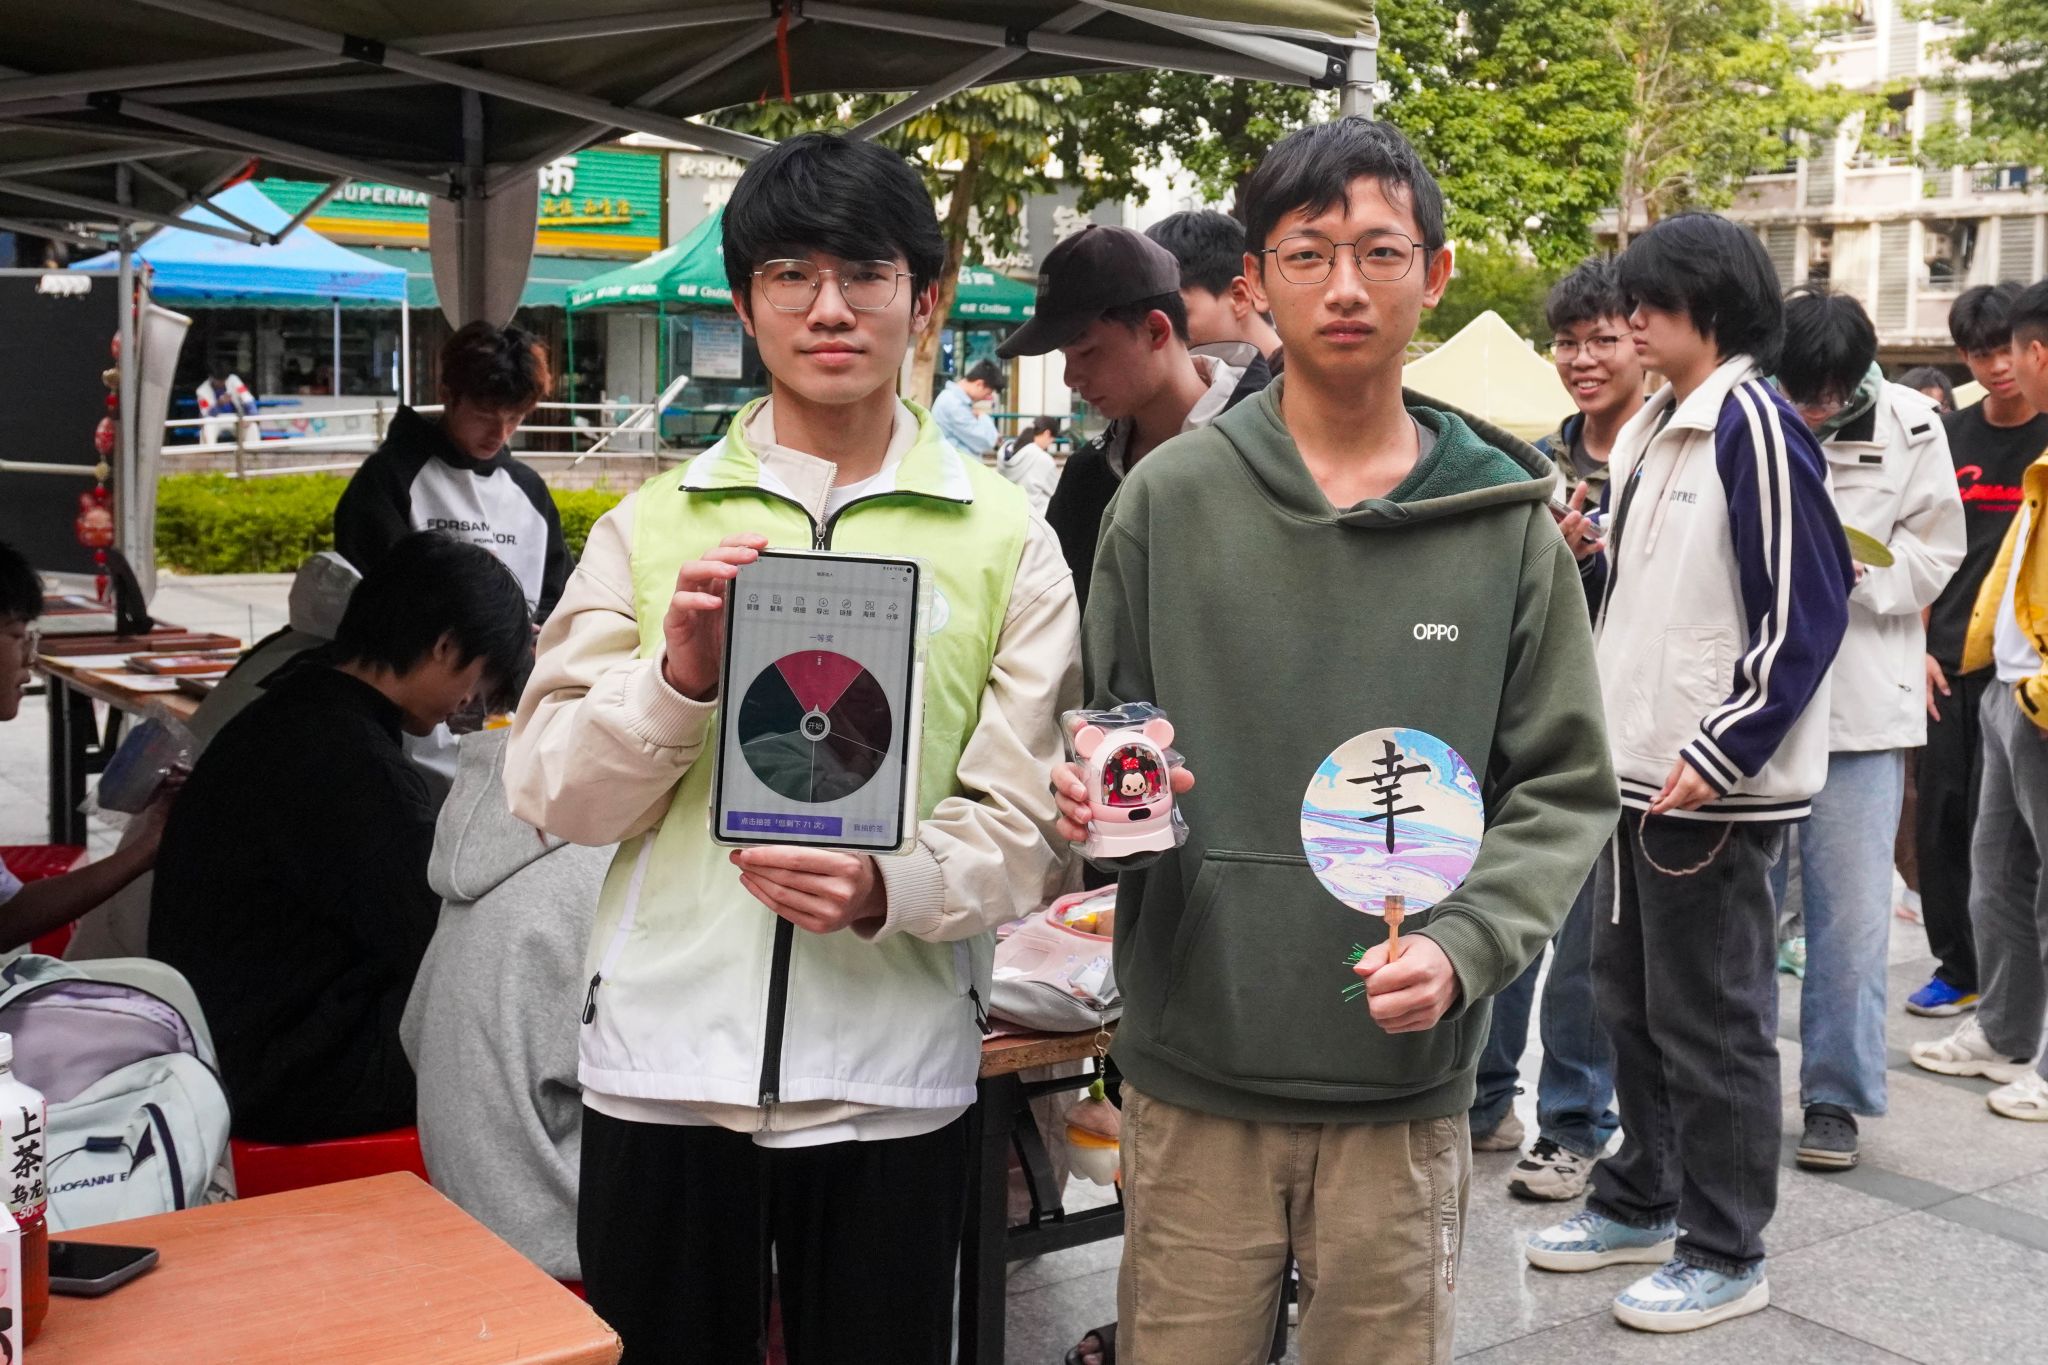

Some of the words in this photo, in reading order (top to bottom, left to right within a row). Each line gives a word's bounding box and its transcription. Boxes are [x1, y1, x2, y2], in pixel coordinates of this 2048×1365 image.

[1413, 623, 1459, 642] OPPO
[809, 633, 835, 643] 一等奖
[807, 721, 823, 730] 开始
